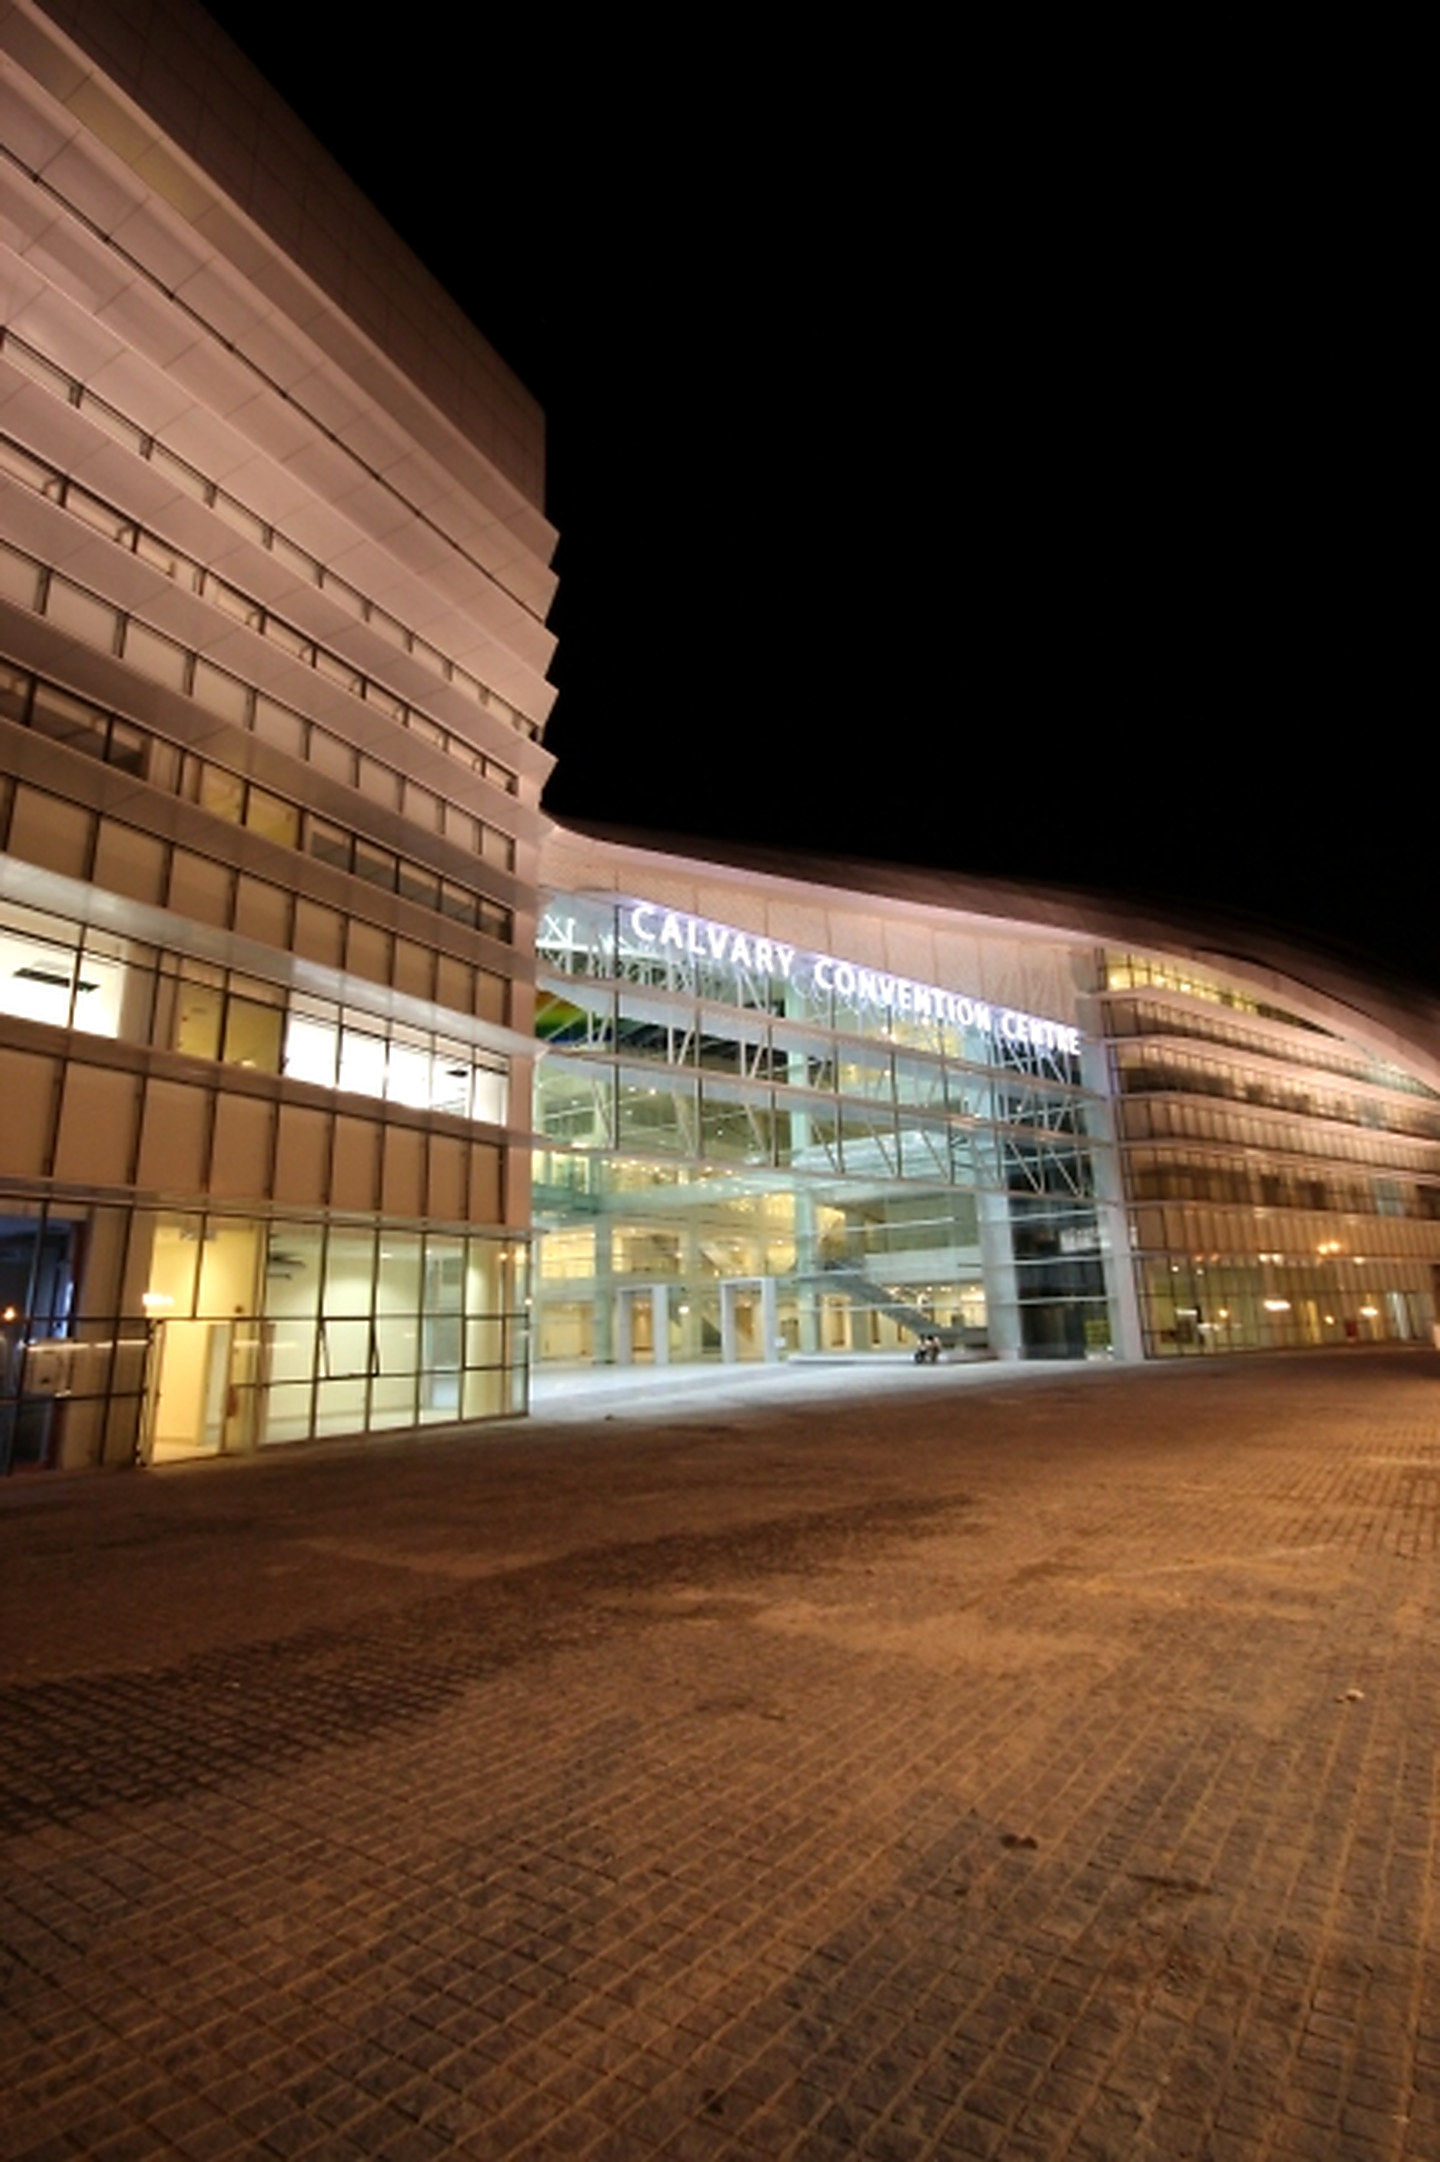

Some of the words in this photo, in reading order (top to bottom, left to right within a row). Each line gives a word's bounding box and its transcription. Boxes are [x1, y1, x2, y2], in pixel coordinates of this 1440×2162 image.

[631, 906, 795, 977] CALVARY
[813, 956, 991, 1032] CONVENTION
[1001, 1011, 1082, 1056] CENTRE
